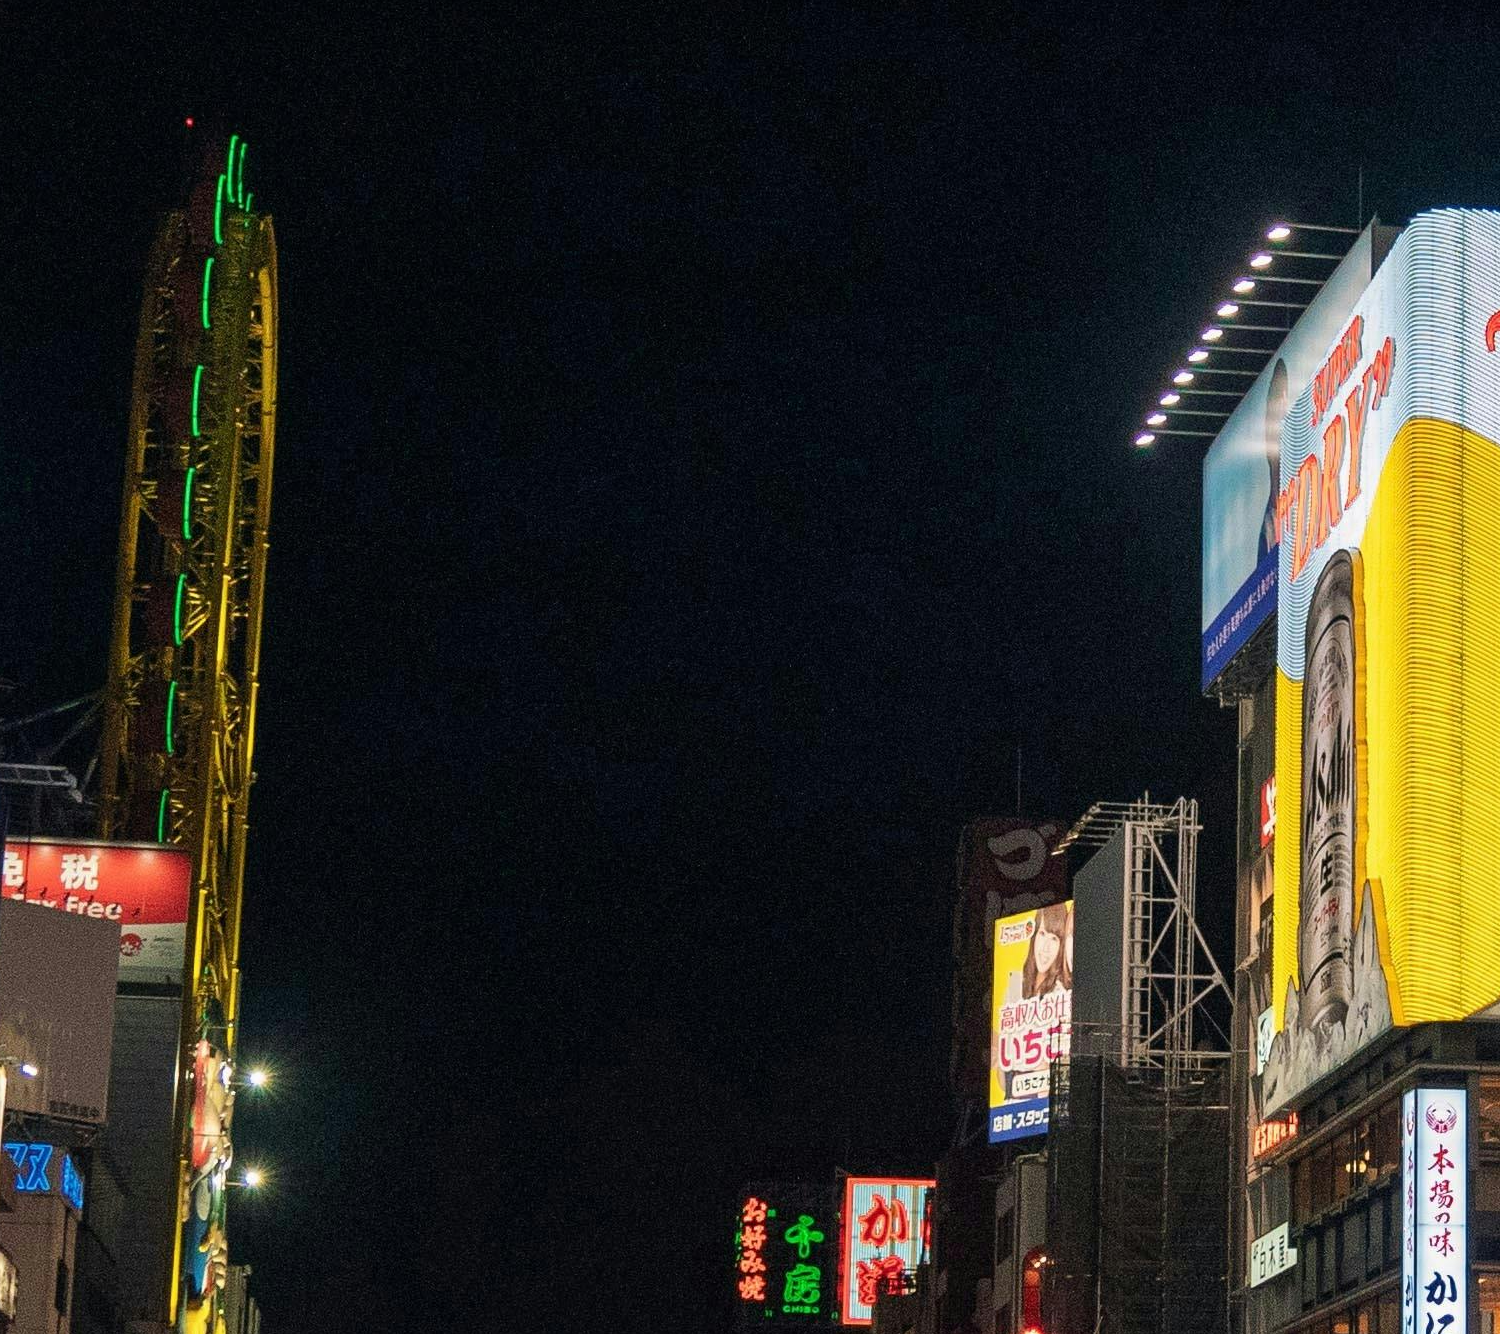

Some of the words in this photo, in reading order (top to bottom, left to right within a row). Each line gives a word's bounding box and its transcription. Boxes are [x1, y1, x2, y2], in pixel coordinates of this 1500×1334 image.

[1000, 994, 1072, 1031] 高収入お仕
[738, 1197, 768, 1303] お好み焼
[1429, 1143, 1456, 1258] 本場の味
